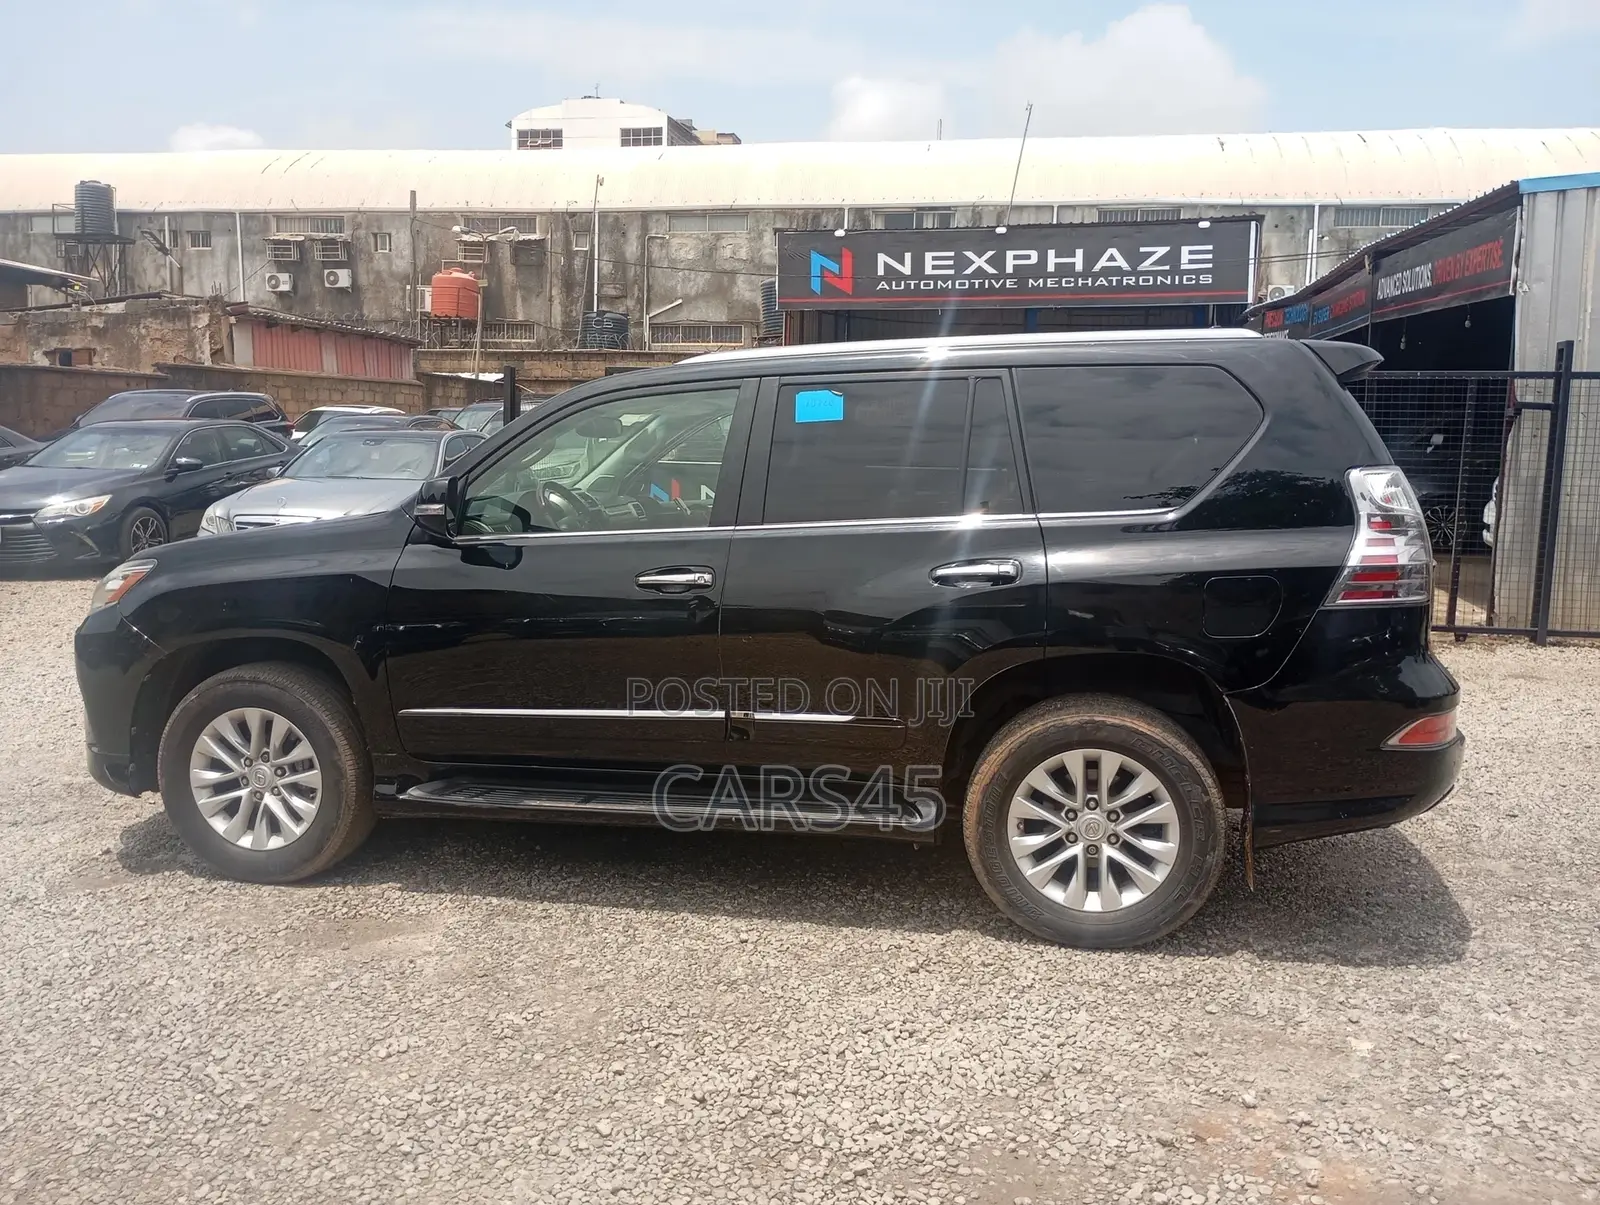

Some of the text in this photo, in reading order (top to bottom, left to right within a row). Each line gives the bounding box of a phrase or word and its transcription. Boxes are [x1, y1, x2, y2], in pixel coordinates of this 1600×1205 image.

[876, 244, 1214, 277] NEXPHAZE
[875, 274, 1213, 291] AUTOMOTIVE MECHATRONICS
